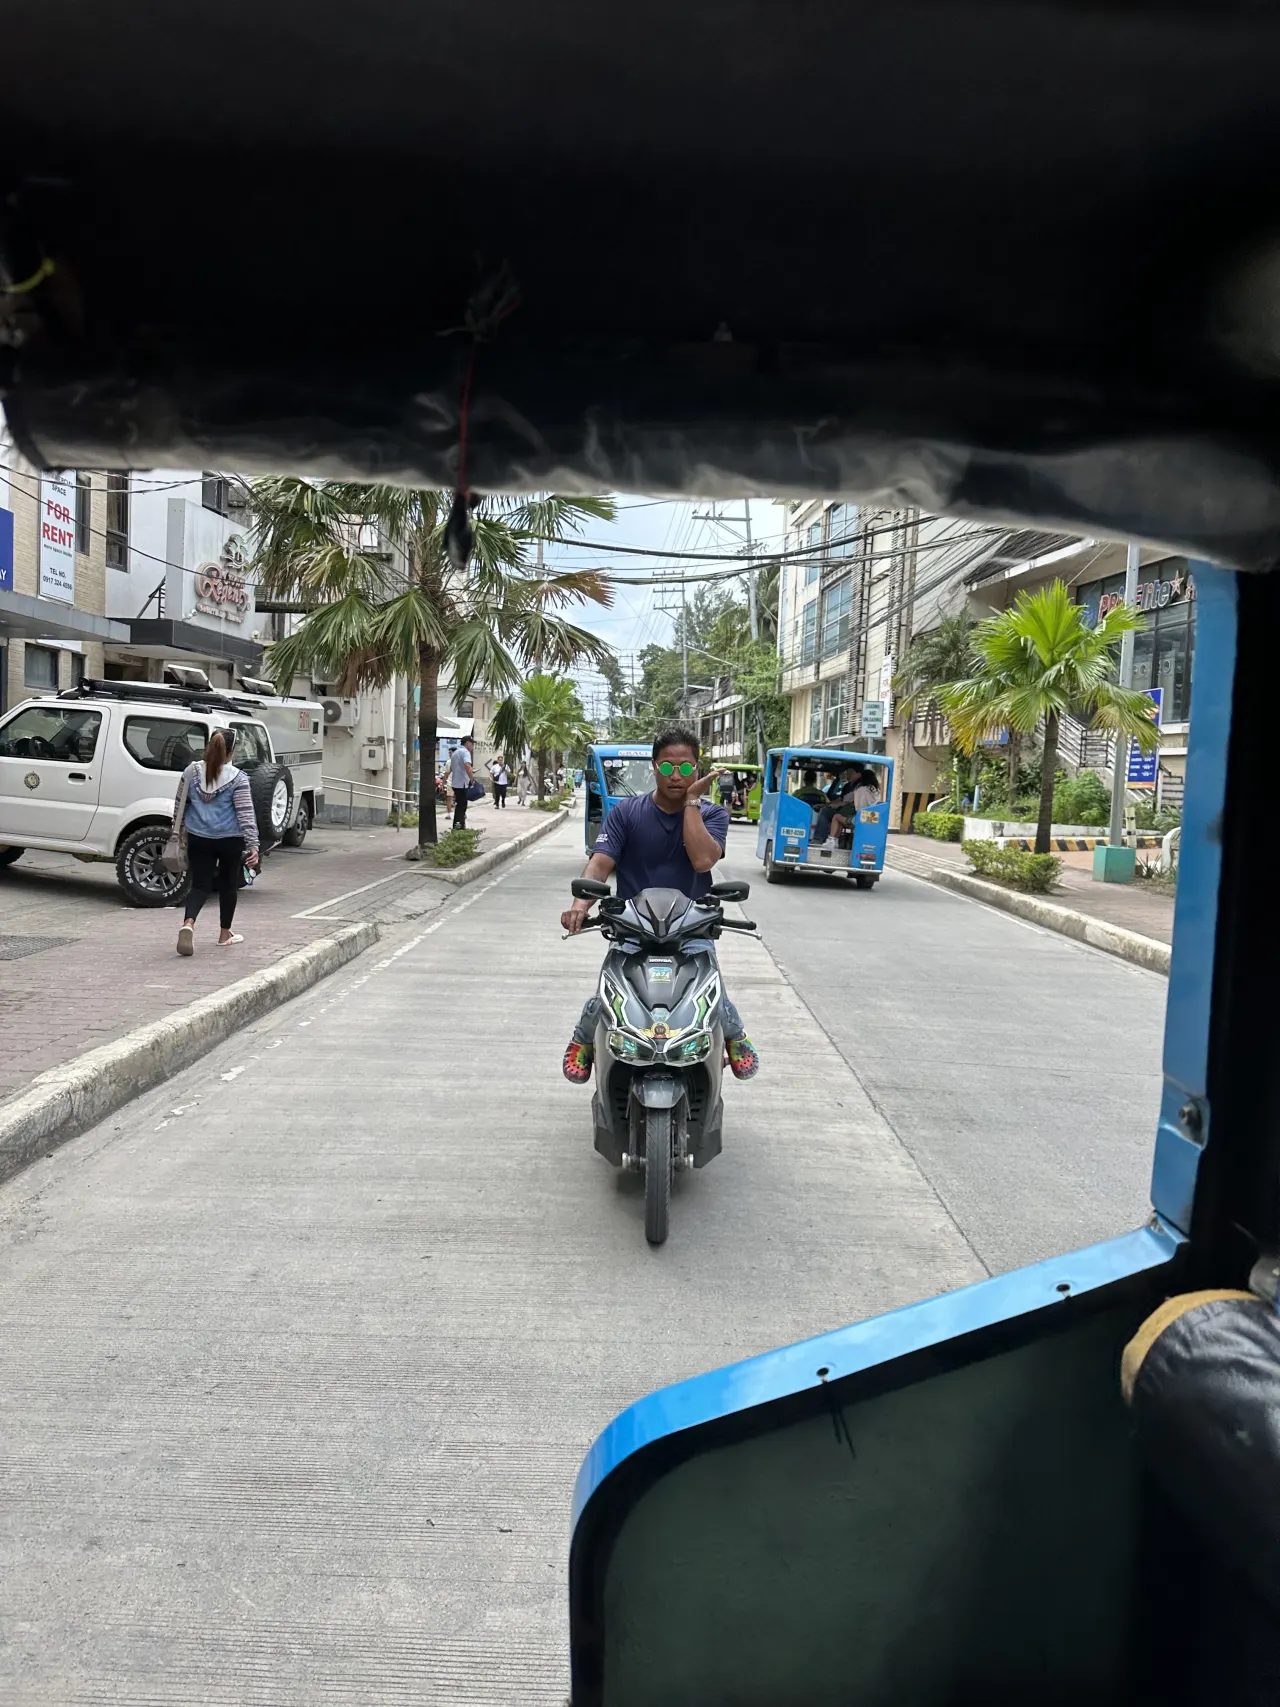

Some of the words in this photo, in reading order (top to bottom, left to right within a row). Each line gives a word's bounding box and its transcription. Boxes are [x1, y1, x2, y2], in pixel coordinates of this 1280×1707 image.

[52, 484, 67, 496] SPACE
[47, 499, 70, 524] FOR
[42, 521, 73, 548] RENT
[50, 567, 58, 576] TEL
[124, 847, 135, 884] SAVERO
[162, 870, 187, 897] RADIAL
